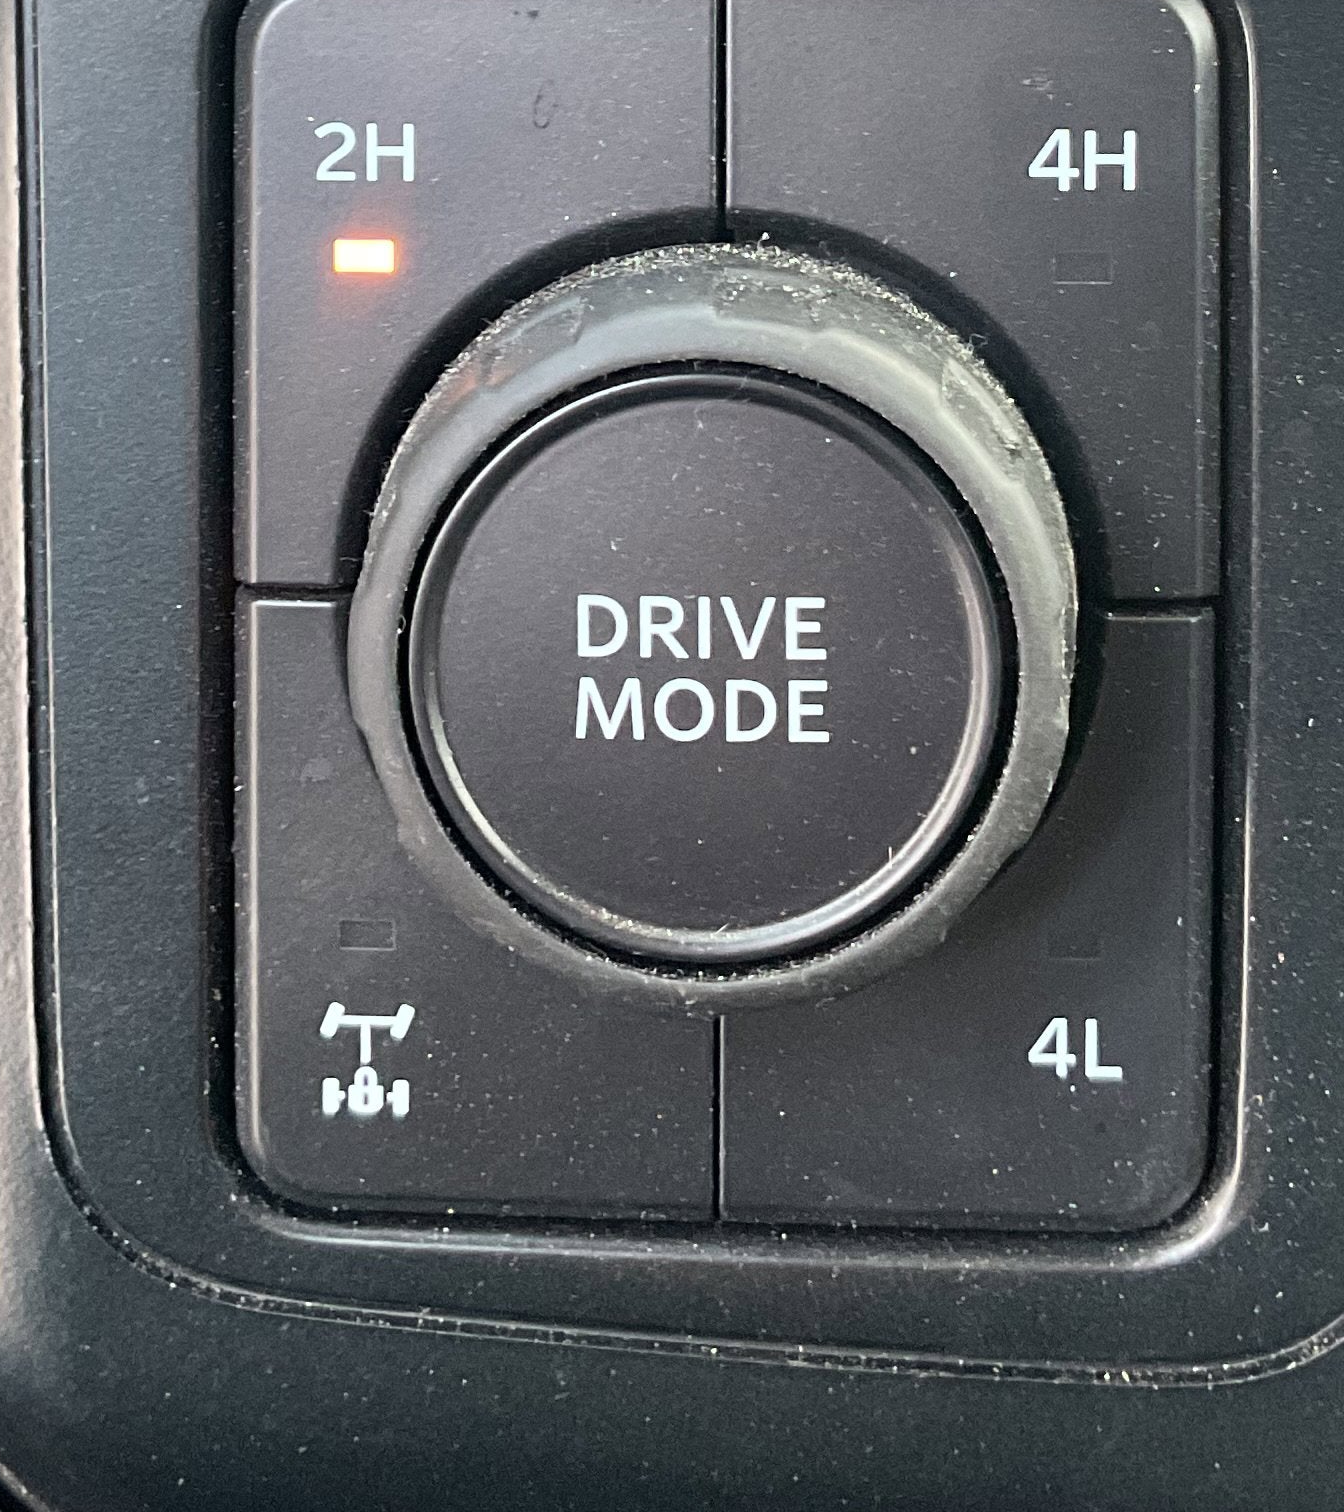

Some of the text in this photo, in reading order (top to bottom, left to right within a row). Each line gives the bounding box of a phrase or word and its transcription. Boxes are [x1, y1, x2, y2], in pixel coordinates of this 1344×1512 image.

[313, 121, 419, 183] 2H
[1027, 127, 1137, 192] 4H
[575, 593, 829, 662] DRIVE
[574, 675, 831, 744] MODE
[1026, 1016, 1124, 1082] 4L
